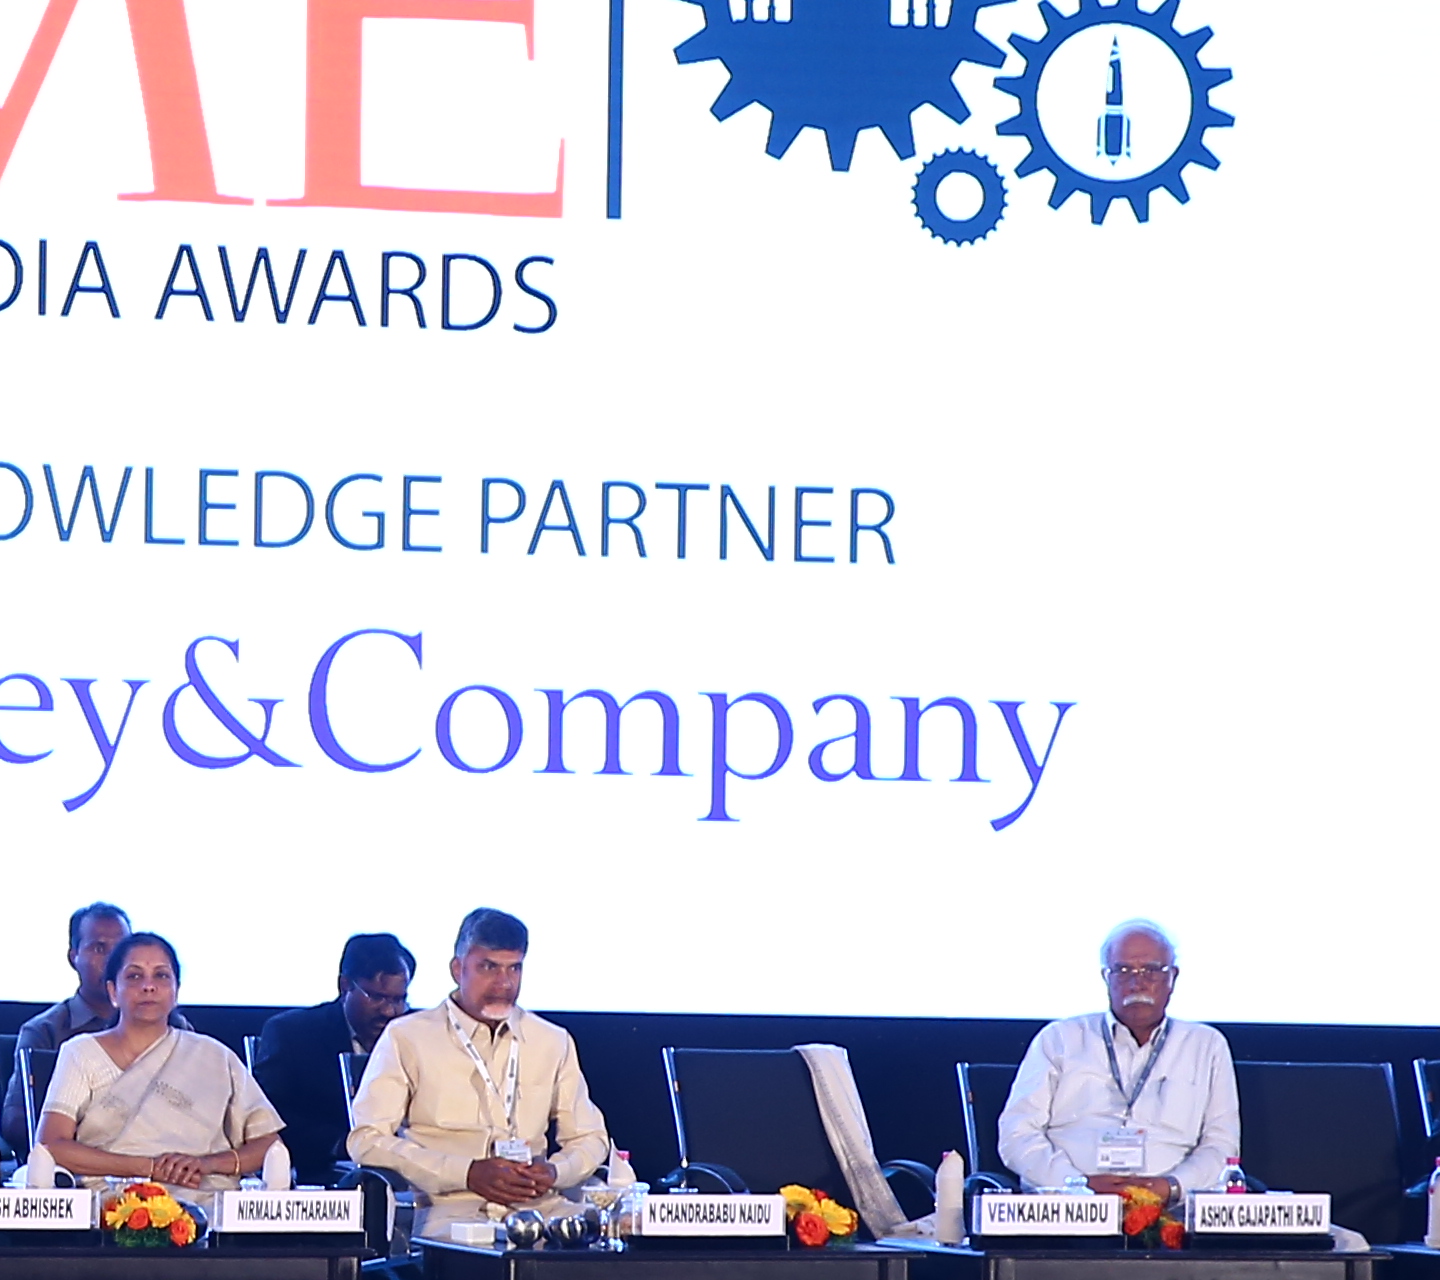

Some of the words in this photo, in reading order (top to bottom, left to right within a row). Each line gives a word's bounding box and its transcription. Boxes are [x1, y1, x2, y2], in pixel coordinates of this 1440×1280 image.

[154, 243, 558, 334] AWARDS
[481, 477, 896, 565] PARTNER
[13, 1197, 73, 1219] ABHISHEK
[237, 1200, 282, 1221] NIRMALA
[285, 1200, 350, 1221] SITHARAMAN
[649, 1203, 657, 1223] N
[659, 1203, 736, 1224] CHANDRABABU
[739, 1203, 771, 1224] NAIDU
[988, 1202, 1061, 1223] VENKAIAH
[1065, 1202, 1108, 1223] NAIDU
[1200, 1205, 1235, 1228] ASHOK
[1237, 1205, 1294, 1228] GAJAPATHI
[1296, 1205, 1323, 1227] RAJU
